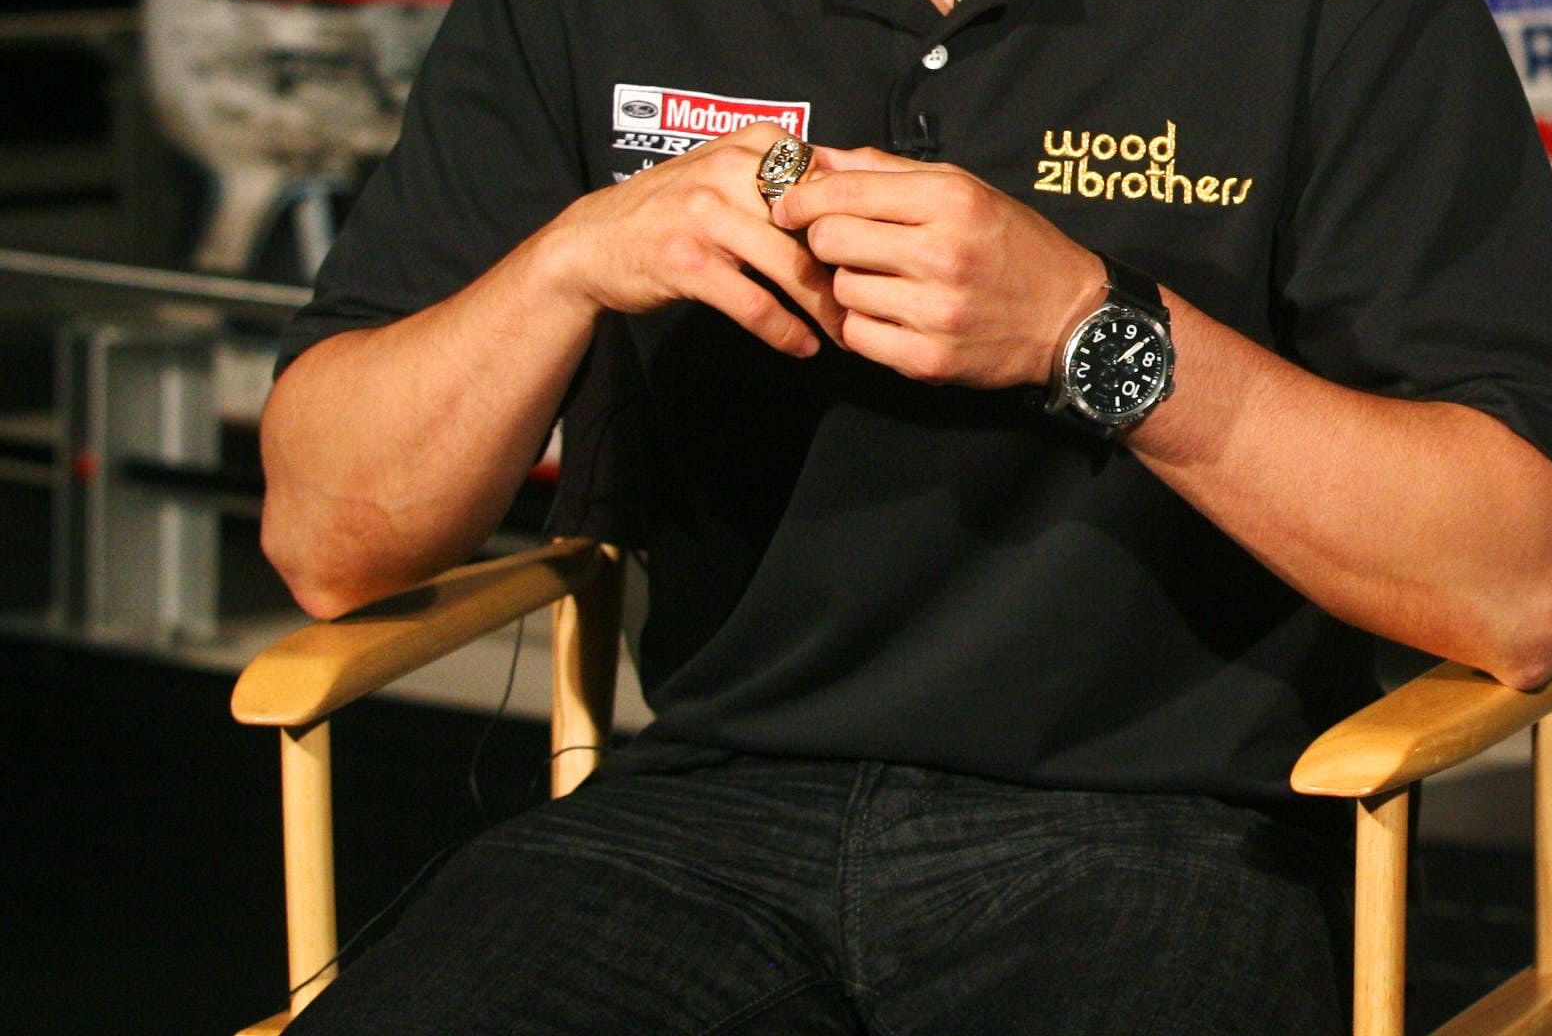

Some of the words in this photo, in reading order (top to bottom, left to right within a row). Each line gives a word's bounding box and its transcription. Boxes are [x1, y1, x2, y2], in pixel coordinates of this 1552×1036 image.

[1043, 119, 1177, 163] wood
[1093, 328, 1107, 343] 4
[1142, 352, 1156, 367] 8
[1077, 362, 1091, 378] 2
